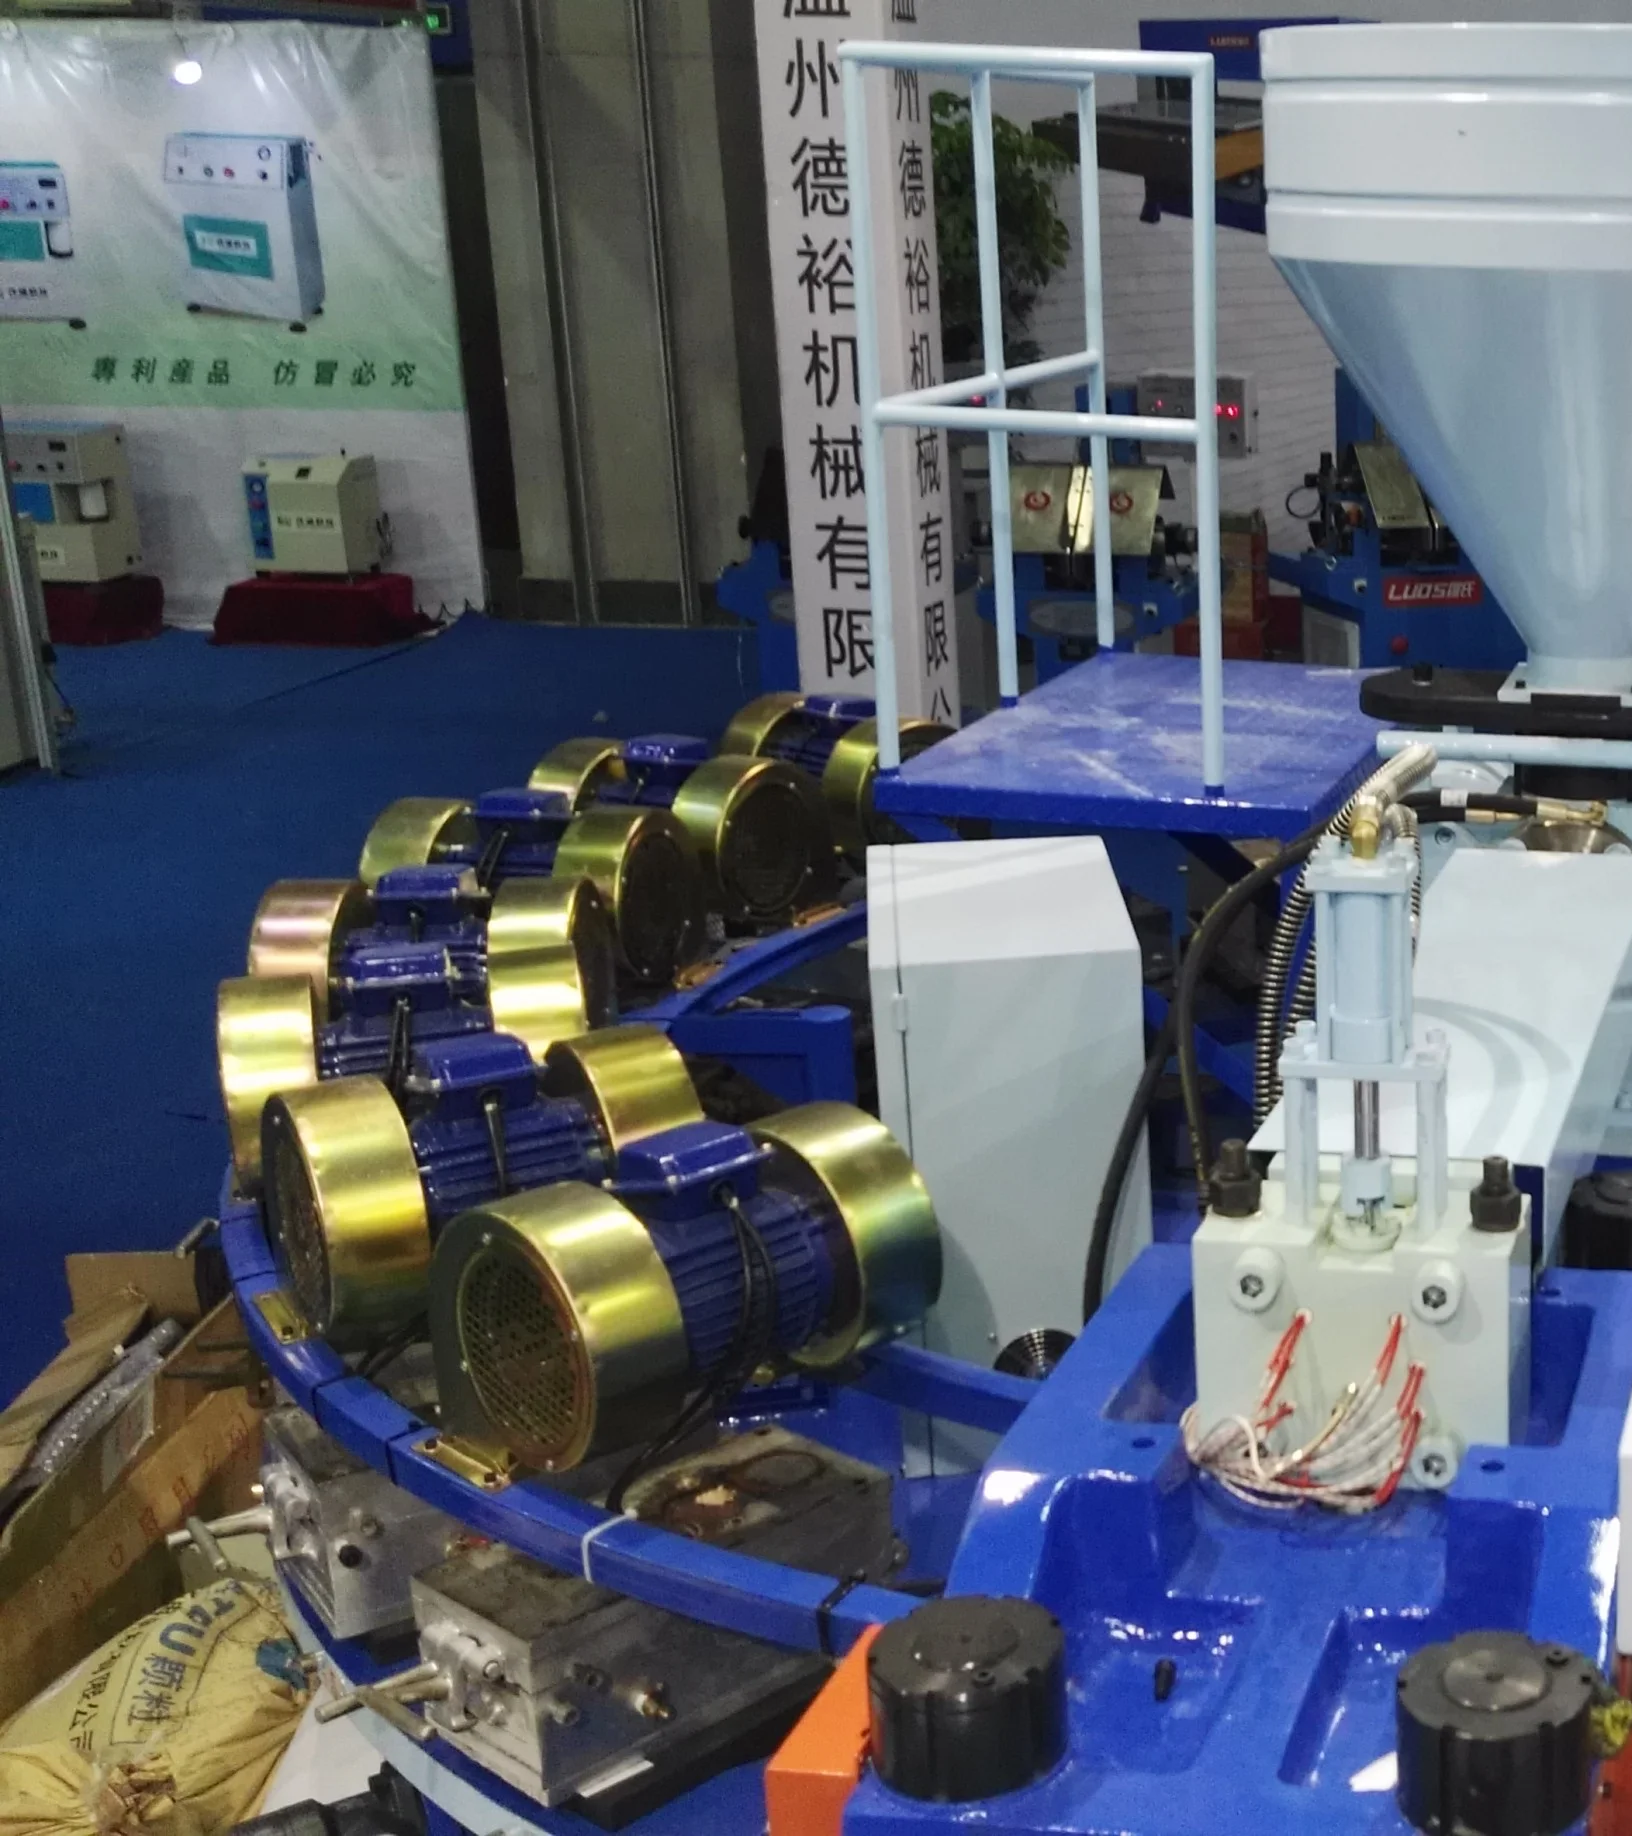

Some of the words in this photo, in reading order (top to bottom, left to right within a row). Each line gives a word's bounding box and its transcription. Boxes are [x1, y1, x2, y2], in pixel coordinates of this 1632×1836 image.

[783, 0, 875, 678] 州德裕机械有限
